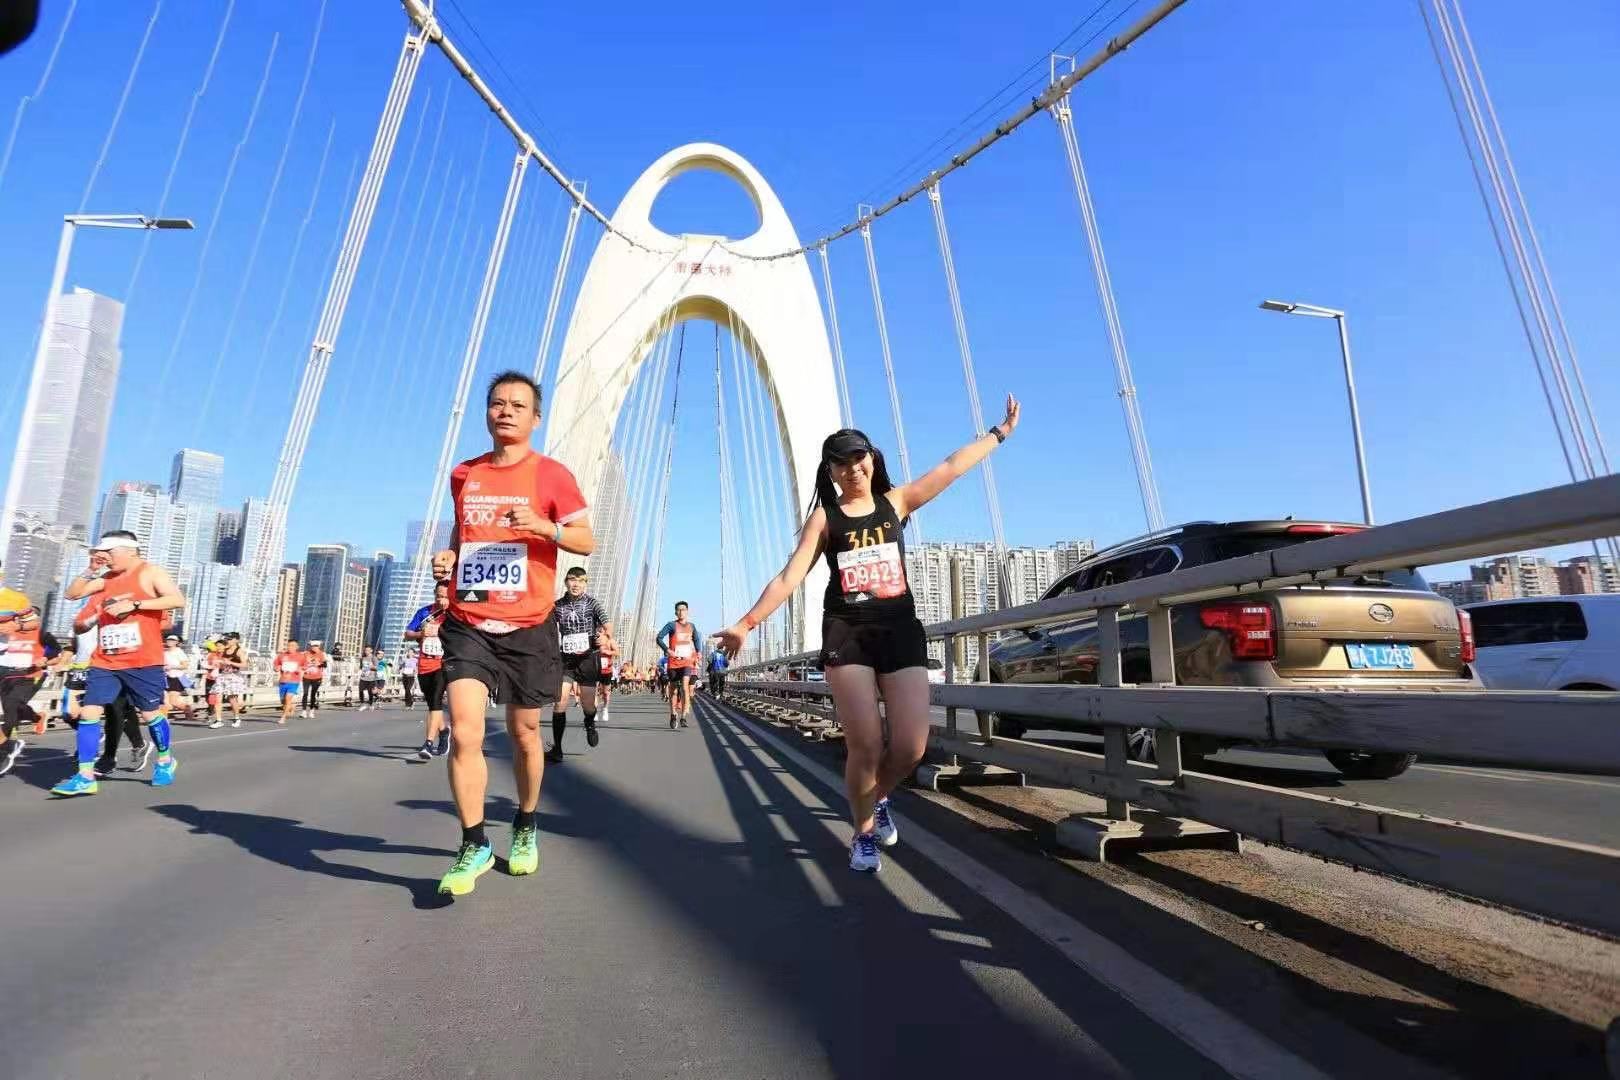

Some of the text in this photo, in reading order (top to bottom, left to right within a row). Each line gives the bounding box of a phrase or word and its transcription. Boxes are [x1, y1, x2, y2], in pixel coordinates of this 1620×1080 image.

[463, 495, 528, 505] GUANGZHOU
[463, 511, 495, 527] 2019
[462, 563, 521, 585] E3499
